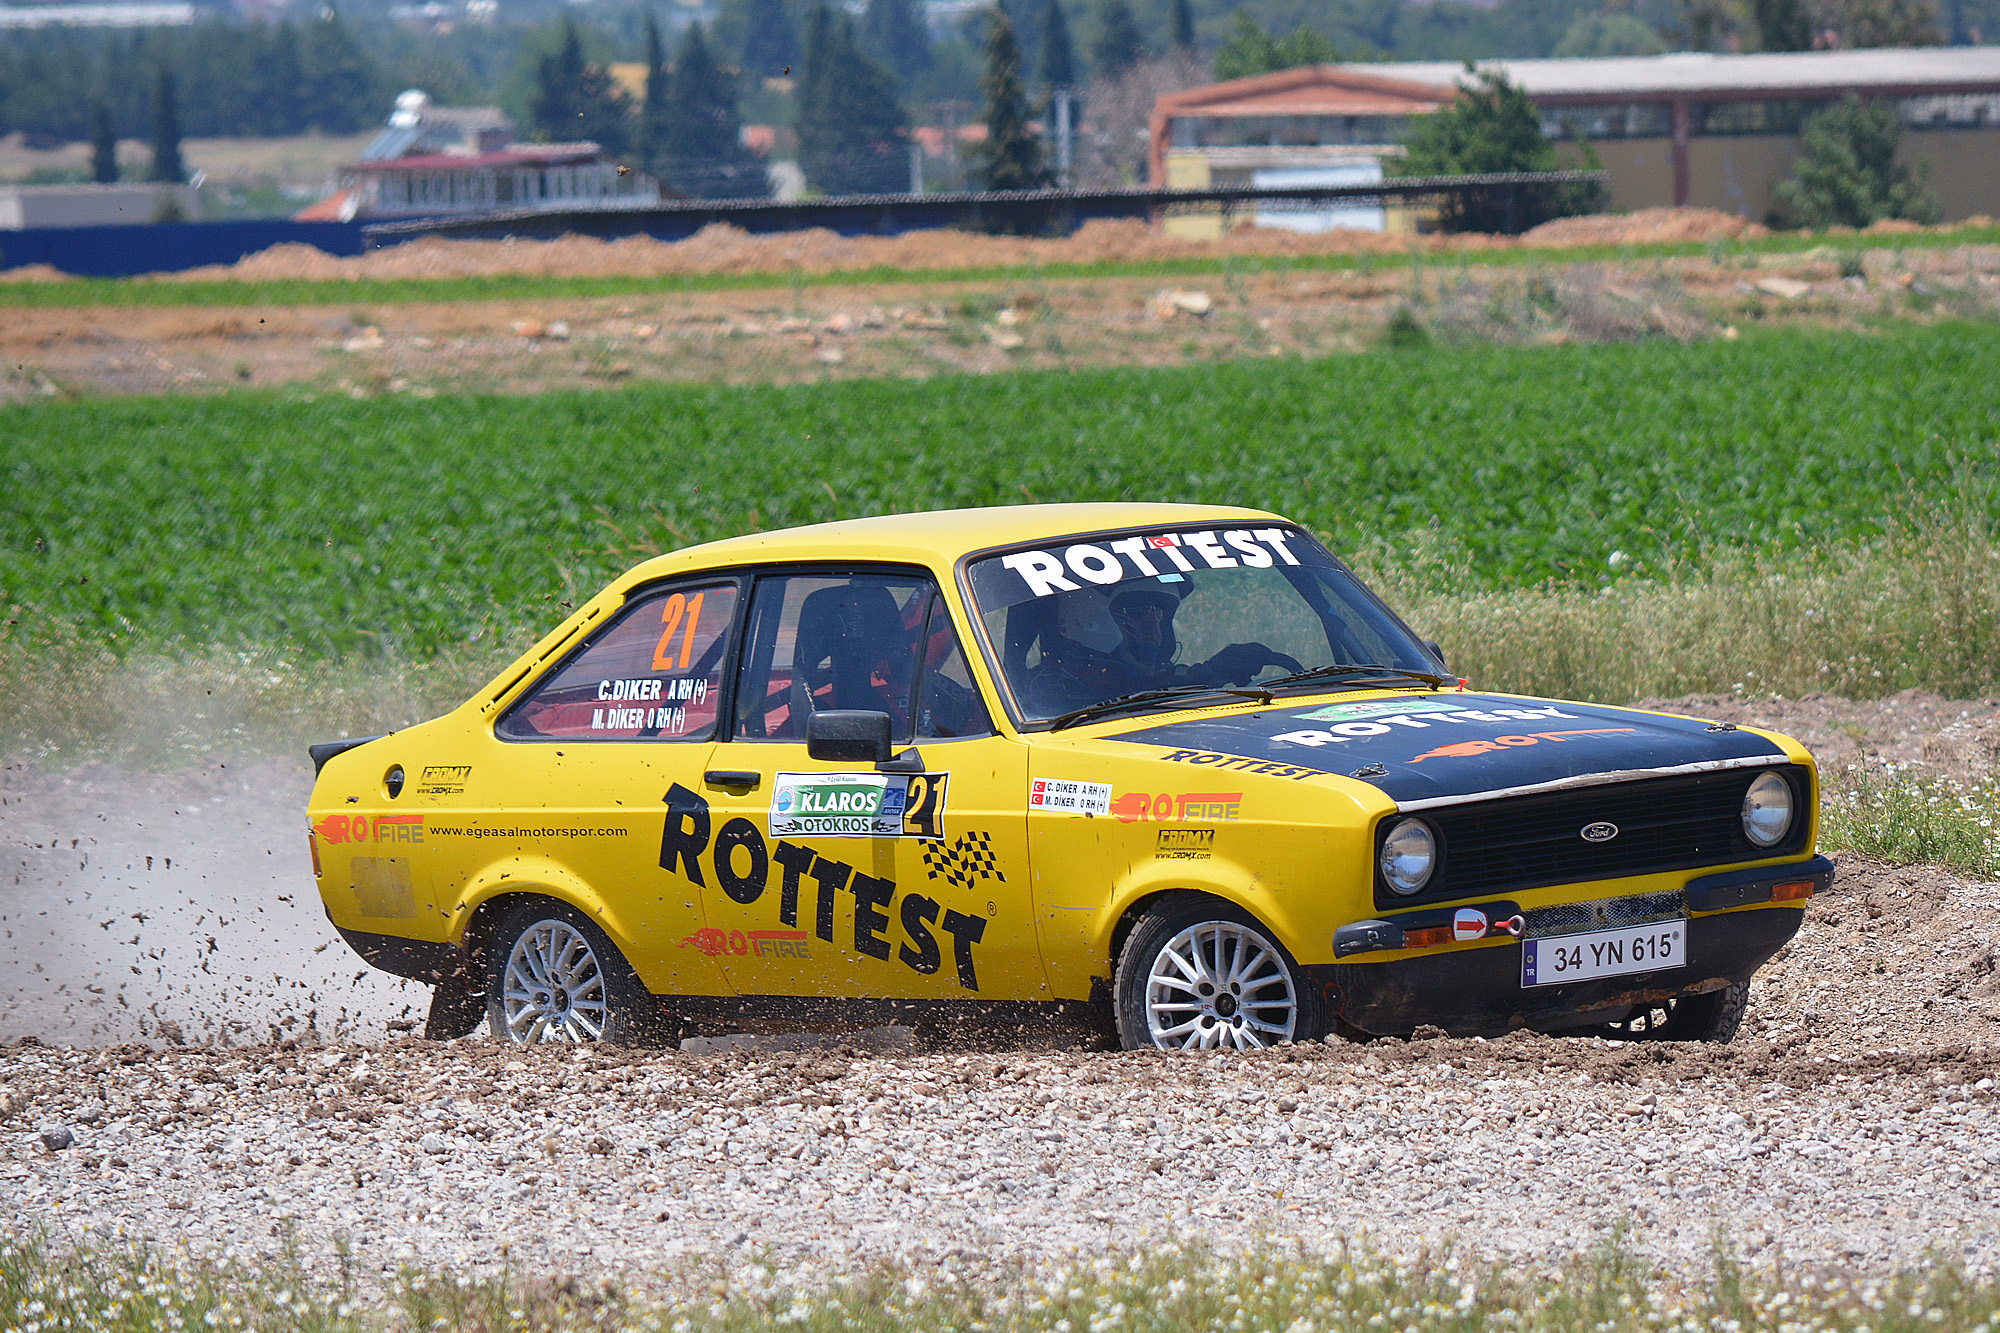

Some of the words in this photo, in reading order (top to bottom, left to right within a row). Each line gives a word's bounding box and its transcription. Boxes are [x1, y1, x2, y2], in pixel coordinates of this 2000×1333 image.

[1001, 527, 1302, 597] ROTTEST
[651, 592, 705, 671] 21
[606, 704, 645, 729] DİKER
[1269, 705, 1580, 747] ROTTEST
[1159, 750, 1329, 780] ROTTEST
[1047, 782, 1054, 792] C.
[1055, 781, 1078, 794] DİKER
[1081, 785, 1087, 794] A
[1088, 785, 1098, 795] RH
[800, 791, 878, 812] KLAROS
[902, 775, 947, 836] 21
[1054, 794, 1075, 807] DİKER
[1085, 799, 1096, 809] RH
[1184, 802, 1241, 822] FIRE
[379, 825, 425, 843] FIRE
[429, 826, 628, 839] www.egeasalmotorspor.com
[804, 818, 870, 832] OTOKROS
[1589, 825, 1610, 838] Ford
[659, 781, 988, 992] ROTTEST
[758, 939, 812, 958] FIRE
[1526, 968, 1535, 976] TR
[1554, 945, 1583, 972] 34
[1590, 939, 1623, 967] YN
[1631, 932, 1671, 962] 615
